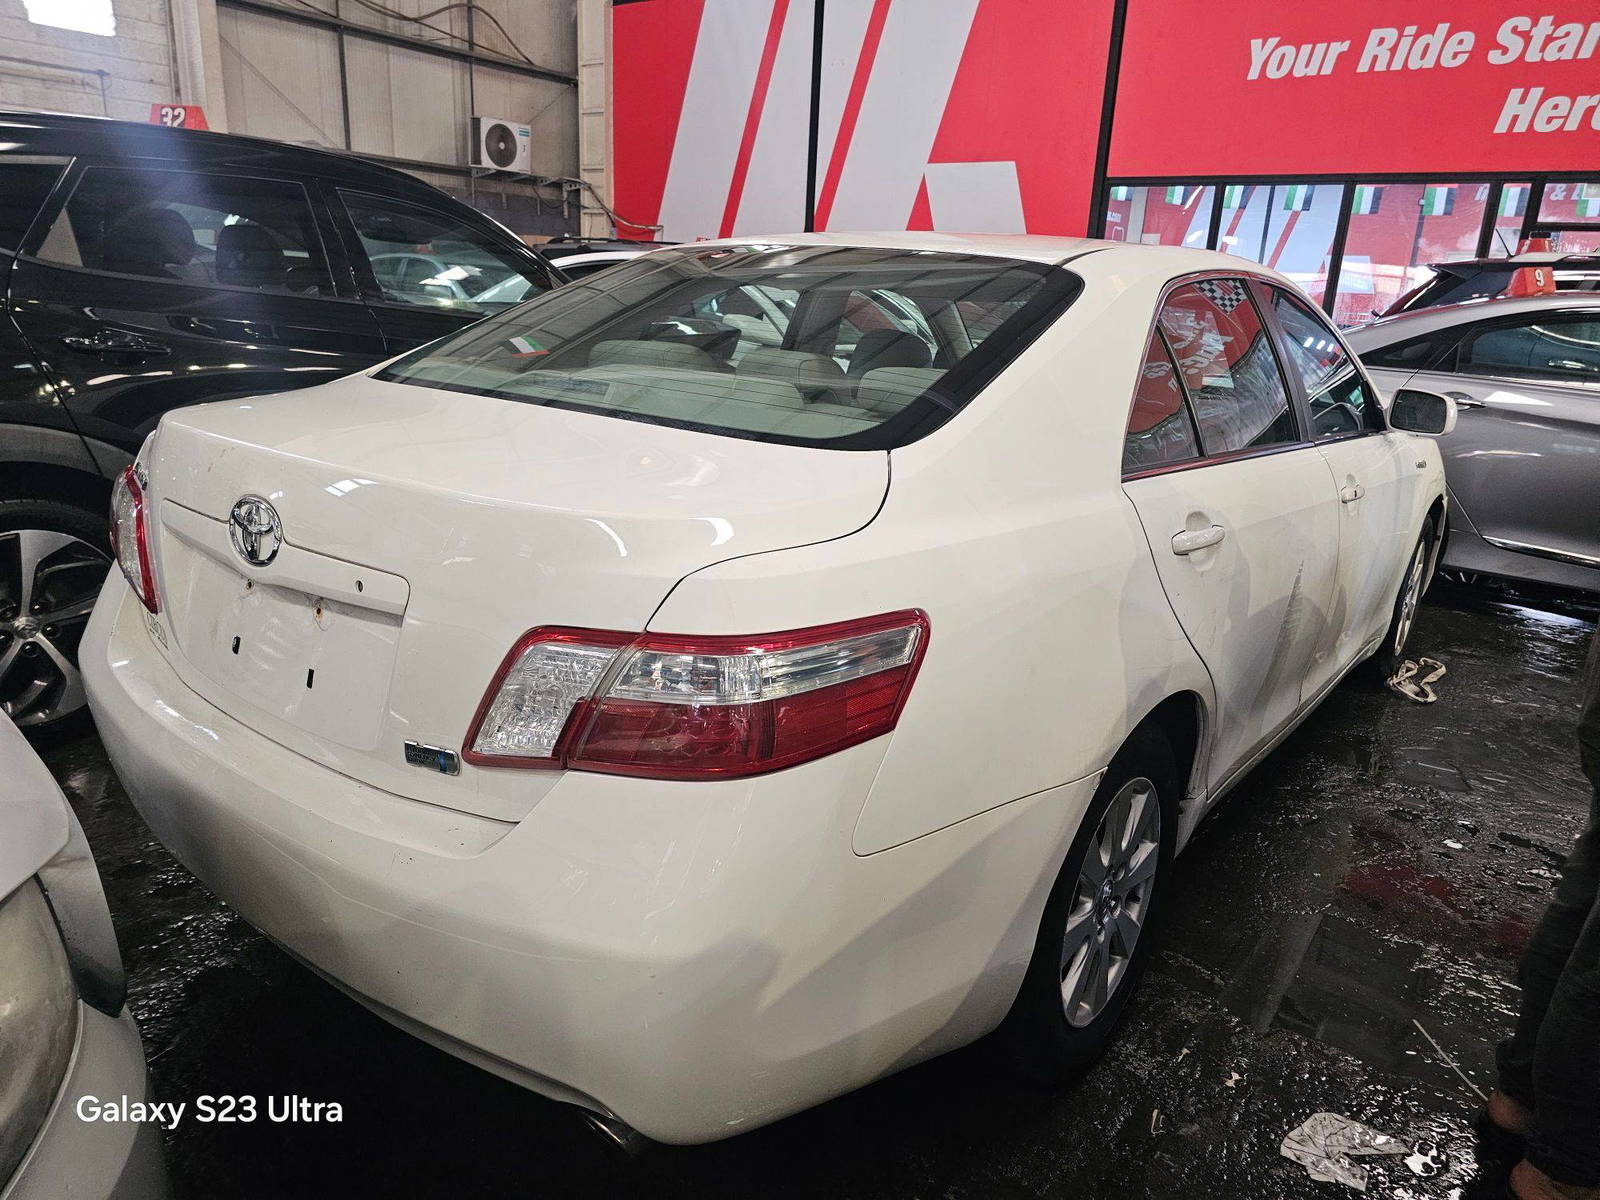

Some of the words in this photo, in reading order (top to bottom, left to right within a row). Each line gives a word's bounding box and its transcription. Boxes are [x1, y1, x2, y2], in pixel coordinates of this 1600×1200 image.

[1247, 37, 1351, 81] Your
[1356, 23, 1475, 73] Ride
[1493, 87, 1600, 134] Her
[1534, 268, 1545, 287] 9
